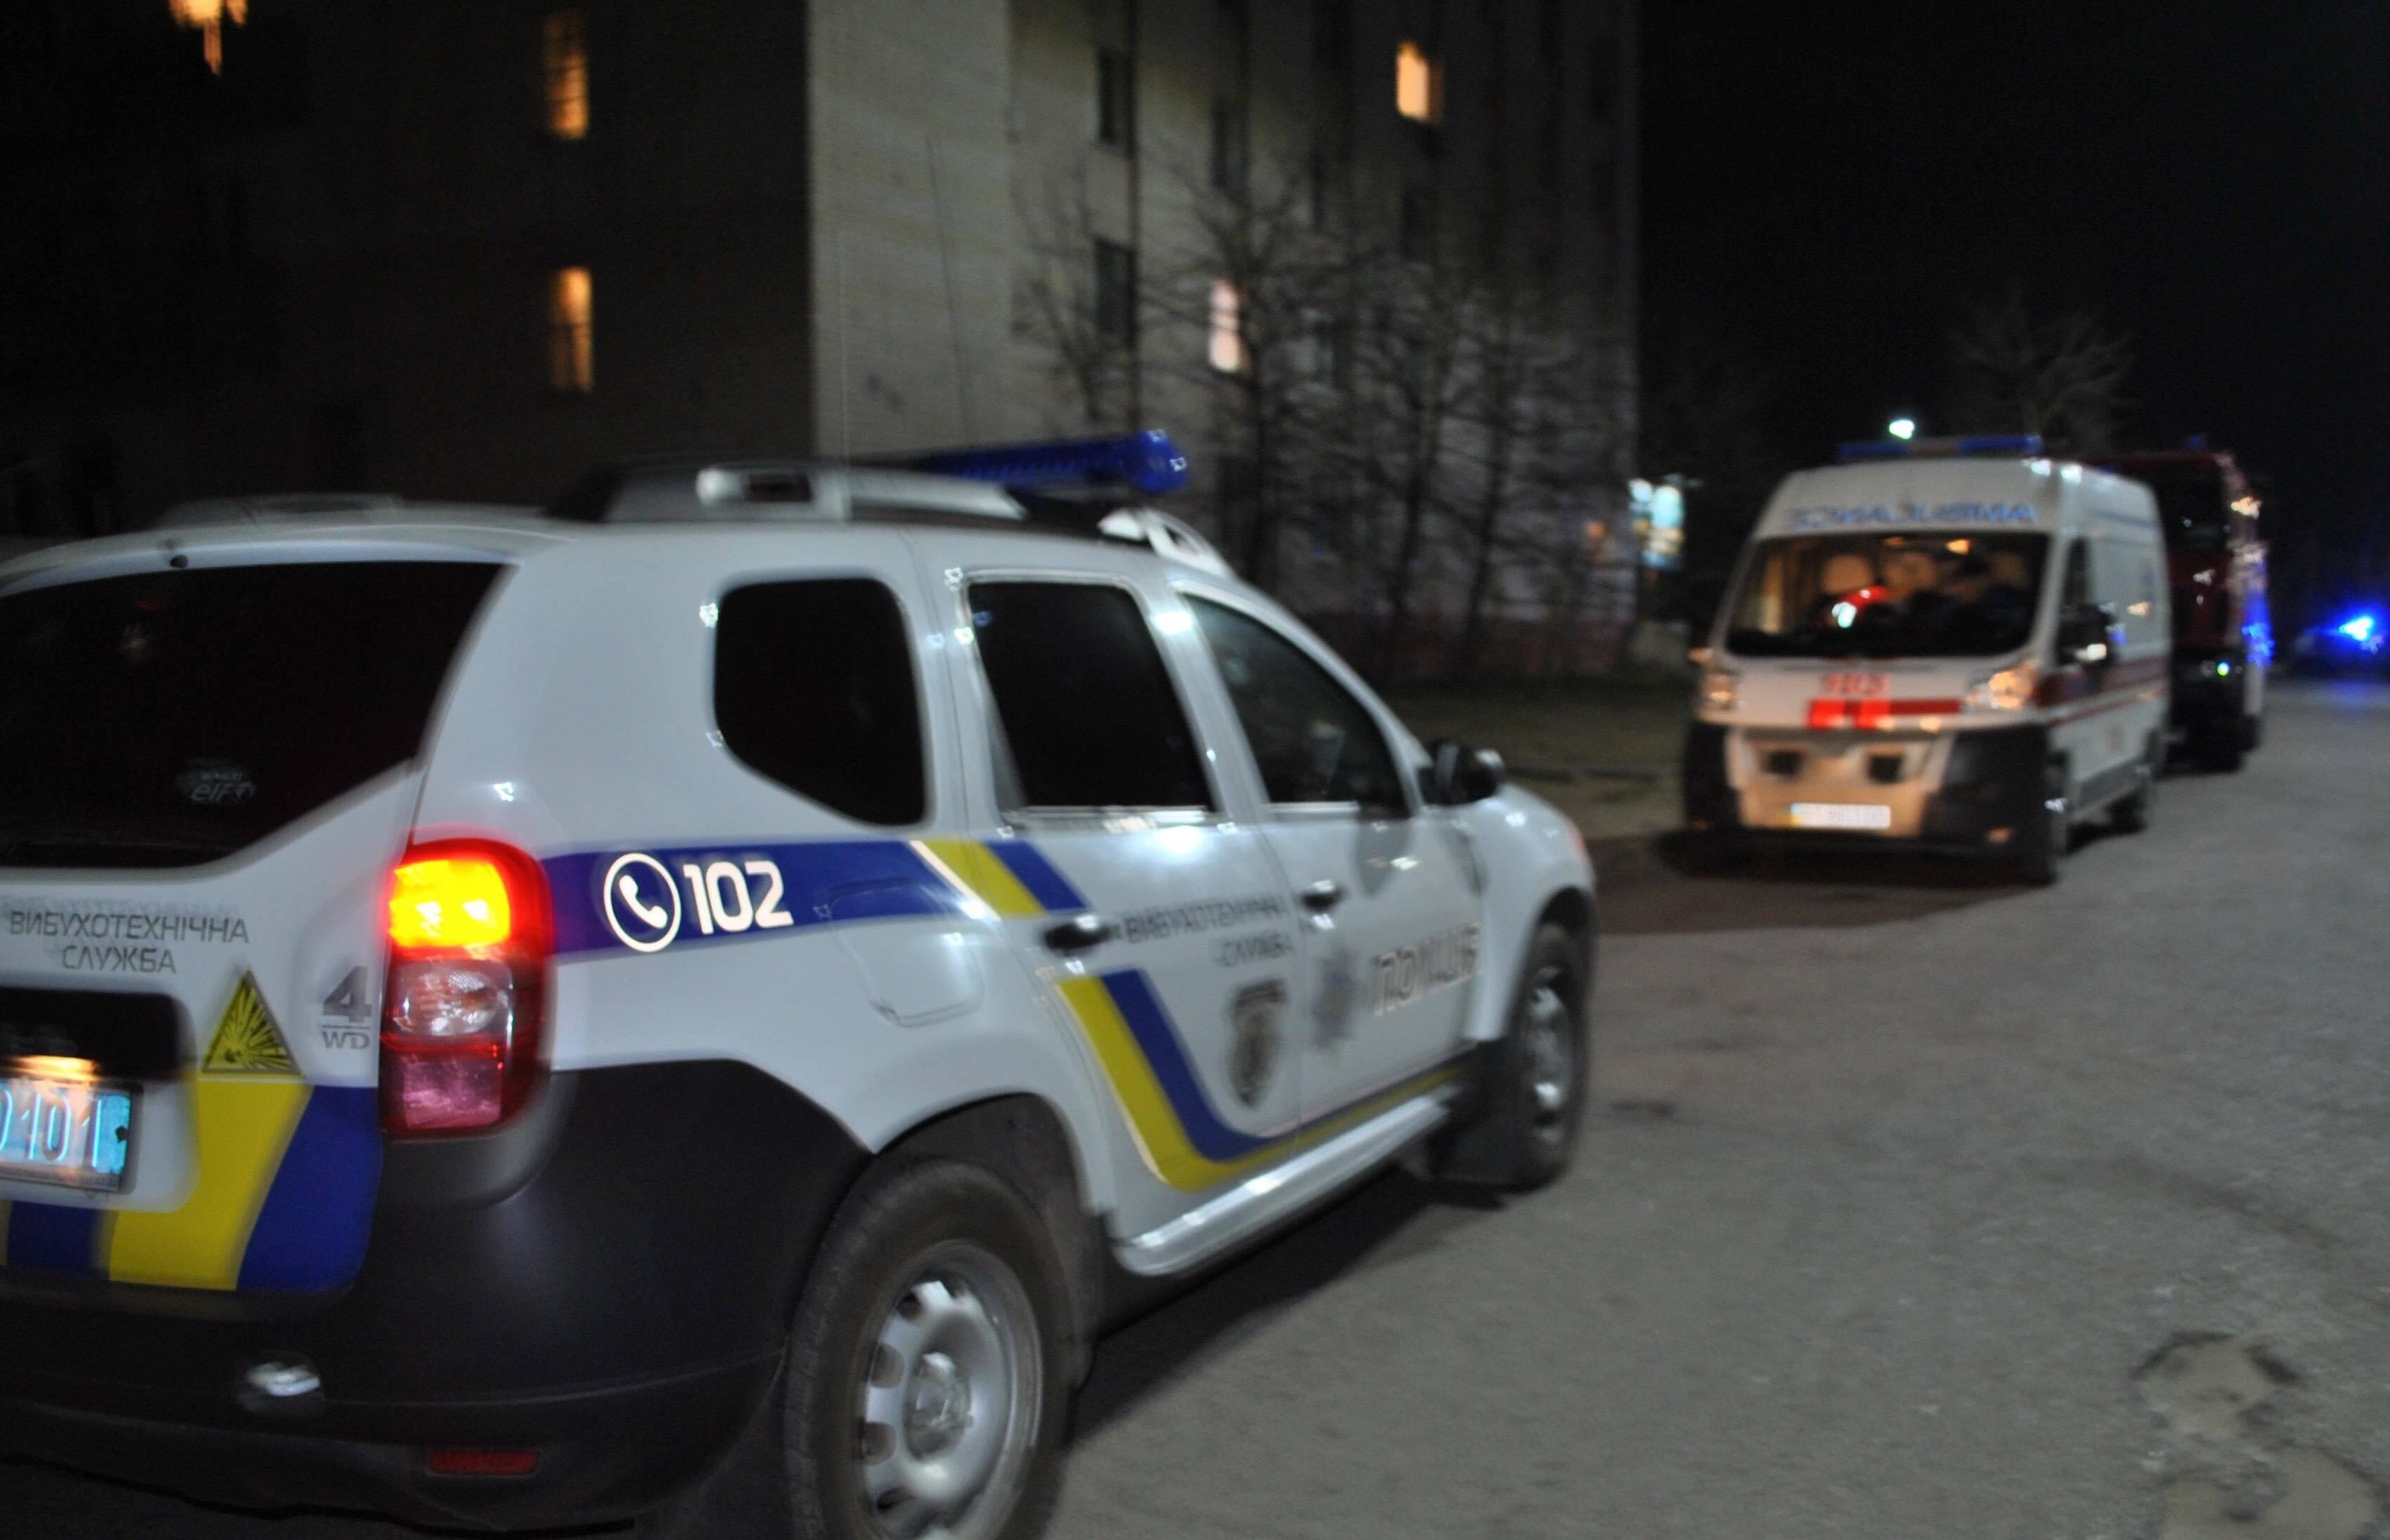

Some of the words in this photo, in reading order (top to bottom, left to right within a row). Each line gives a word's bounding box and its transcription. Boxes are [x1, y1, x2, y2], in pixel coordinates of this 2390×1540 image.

[683, 861, 794, 934] 102
[10, 911, 249, 943] ВИБУХОТЕХНІЧНА
[62, 945, 176, 974] СЛУЖБА
[323, 965, 371, 1023] 4
[322, 1032, 371, 1049] WD
